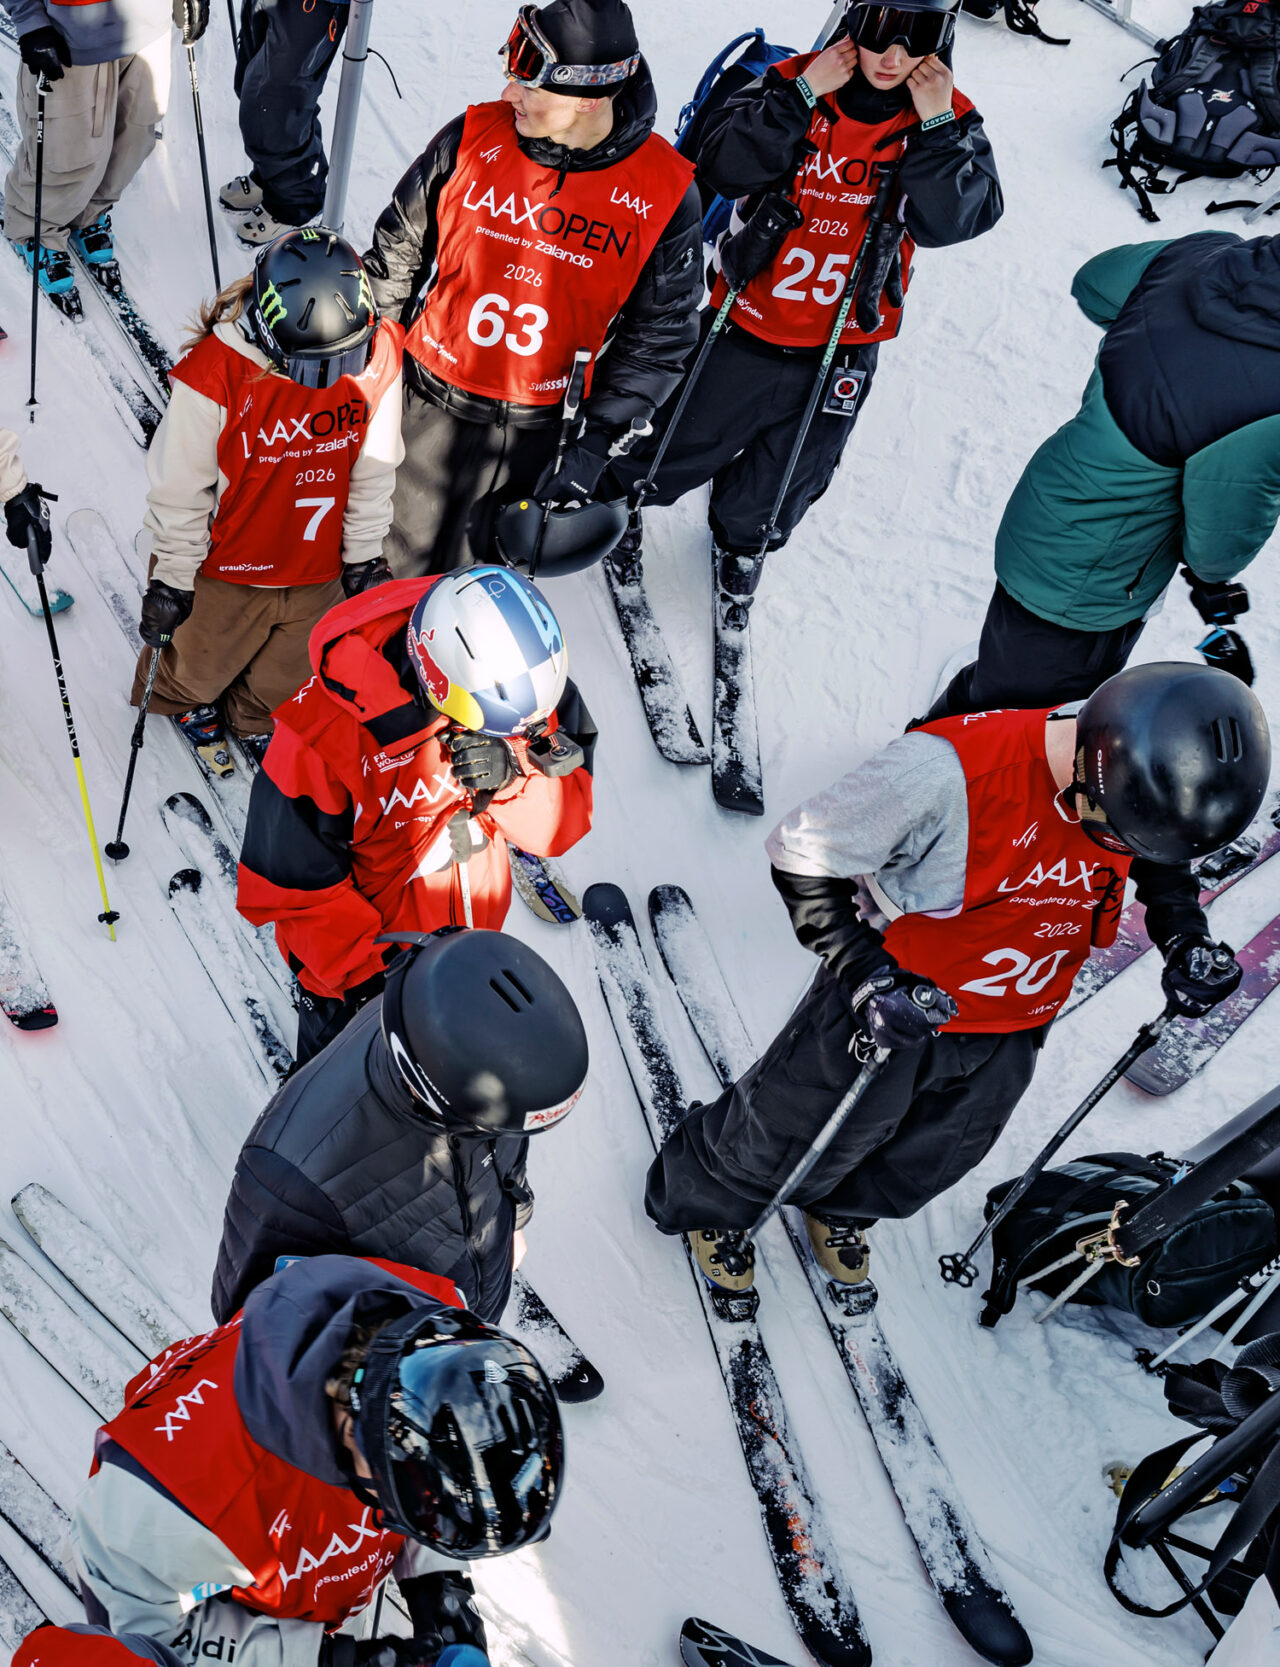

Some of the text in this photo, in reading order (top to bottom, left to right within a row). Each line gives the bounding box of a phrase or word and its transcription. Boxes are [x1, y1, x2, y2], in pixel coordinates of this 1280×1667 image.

[36, 111, 44, 143] LEKI
[610, 186, 653, 219] LAAX
[826, 191, 838, 203] by
[839, 192, 877, 206] zalan
[809, 218, 849, 237] 2026
[475, 224, 594, 269] presented by zalando
[503, 263, 543, 288] 2026
[772, 247, 851, 305] 25
[466, 292, 549, 357] 63
[528, 375, 569, 392] swisss
[302, 446, 313, 458] by
[295, 467, 336, 486] 2026
[294, 496, 336, 541] 7
[1068, 897, 1081, 910] by
[1033, 921, 1081, 940] 2026
[959, 947, 1070, 997] 20
[154, 1378, 220, 1442] LAAX
[367, 1548, 381, 1567] by
[169, 1629, 238, 1666] Adi
